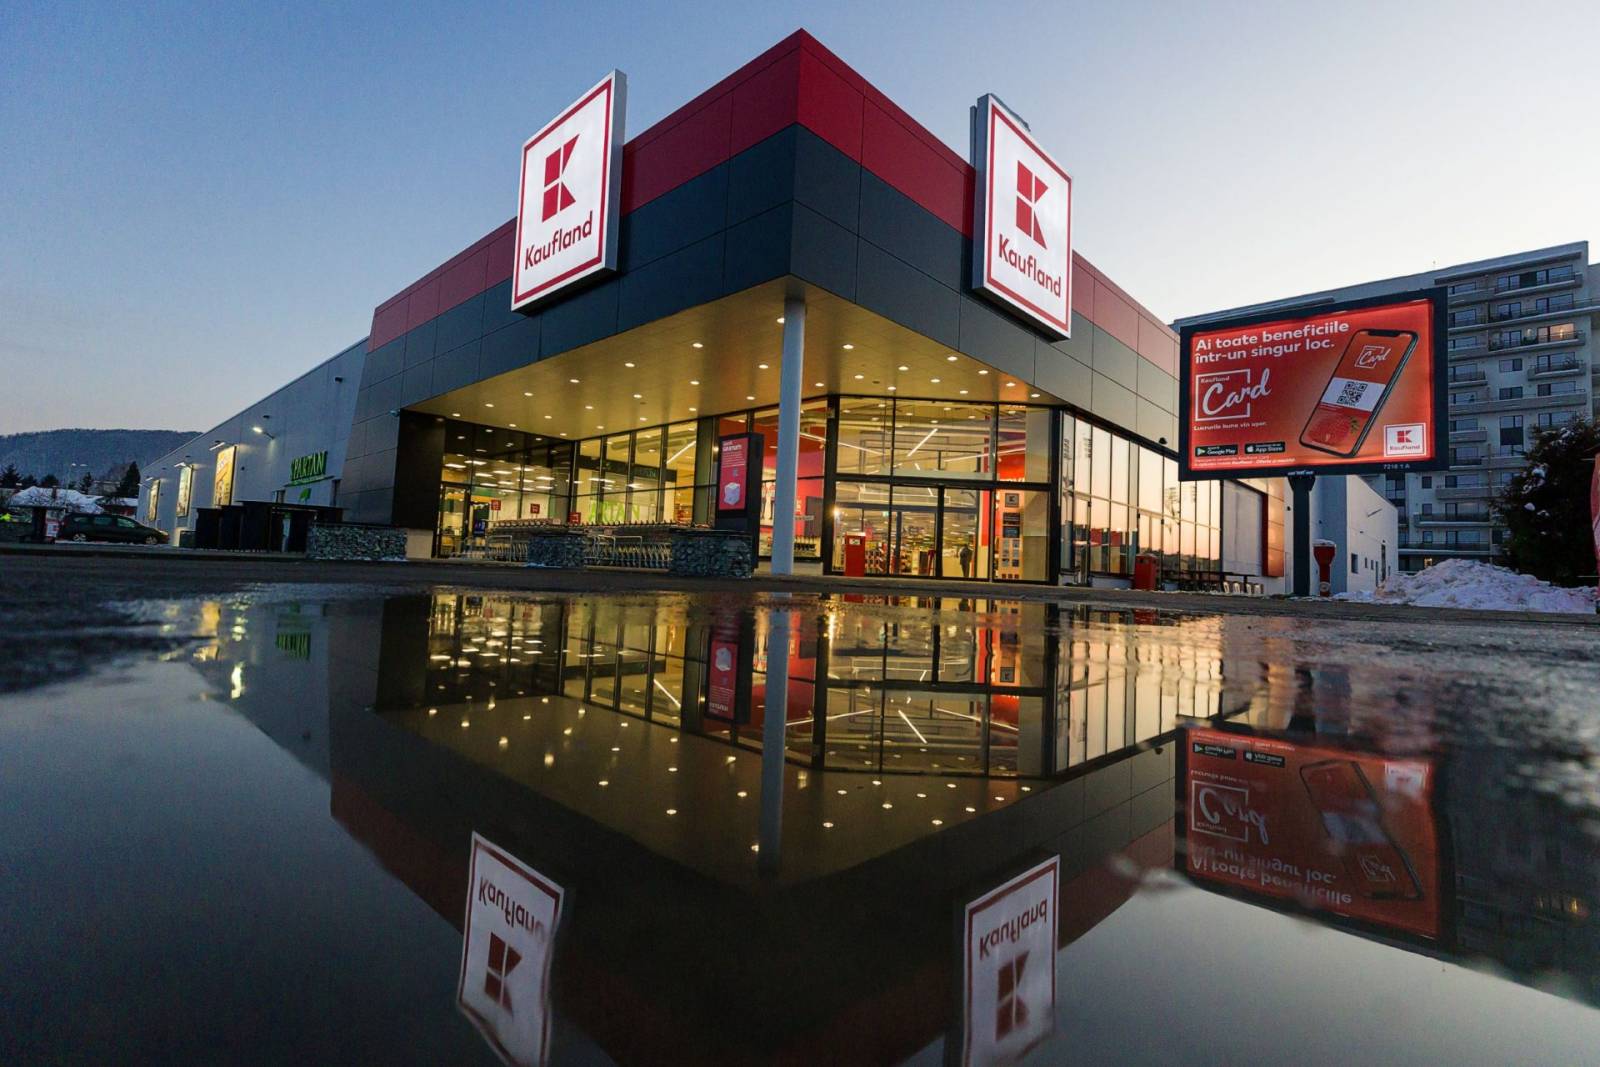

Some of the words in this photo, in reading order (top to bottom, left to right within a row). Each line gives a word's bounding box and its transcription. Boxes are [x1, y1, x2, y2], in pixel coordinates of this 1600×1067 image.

[524, 210, 593, 271] Kaufland
[998, 233, 1062, 298] Kaufland
[1194, 349, 1247, 364] într-un
[1251, 343, 1301, 357] singur
[1306, 338, 1335, 350] loc.
[1195, 339, 1211, 351] Ai
[1215, 334, 1258, 349] toate
[1262, 321, 1350, 343] beneficiile
[1202, 368, 1272, 415] Card
